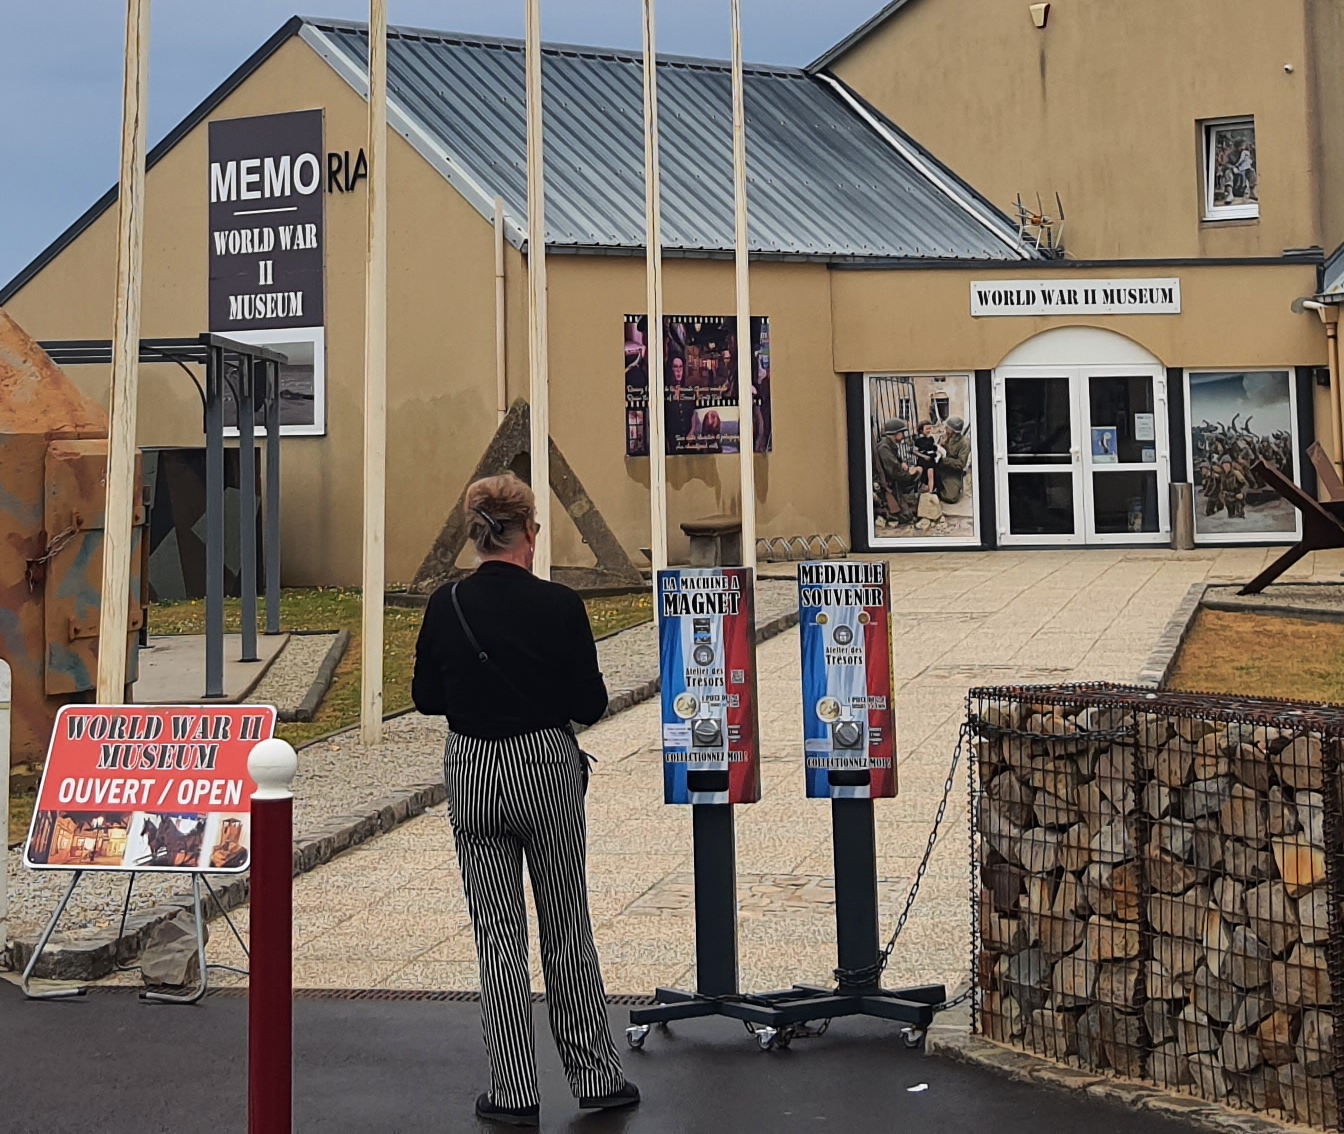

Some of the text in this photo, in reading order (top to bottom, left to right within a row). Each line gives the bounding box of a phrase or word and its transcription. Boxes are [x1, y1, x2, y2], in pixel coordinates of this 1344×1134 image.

[210, 148, 367, 203] MEMORIA
[214, 223, 318, 256] WORLD WAR
[258, 260, 274, 285] II
[228, 291, 303, 320] MUSEUM
[977, 287, 1174, 306] WORLD WAR II MUSEUM
[663, 576, 740, 591] LA MACHINE A
[800, 564, 883, 584] MEDAILLE
[663, 591, 740, 616] MAGNET
[802, 588, 883, 606] SOUVENIR
[66, 714, 264, 740] WORLD WAR II
[96, 744, 219, 770] MUSEUM
[666, 752, 725, 762] COLLECTIONNEZ
[807, 757, 867, 768] COLLECTIONNEZ
[58, 777, 243, 805] OUVERT / OPEN
